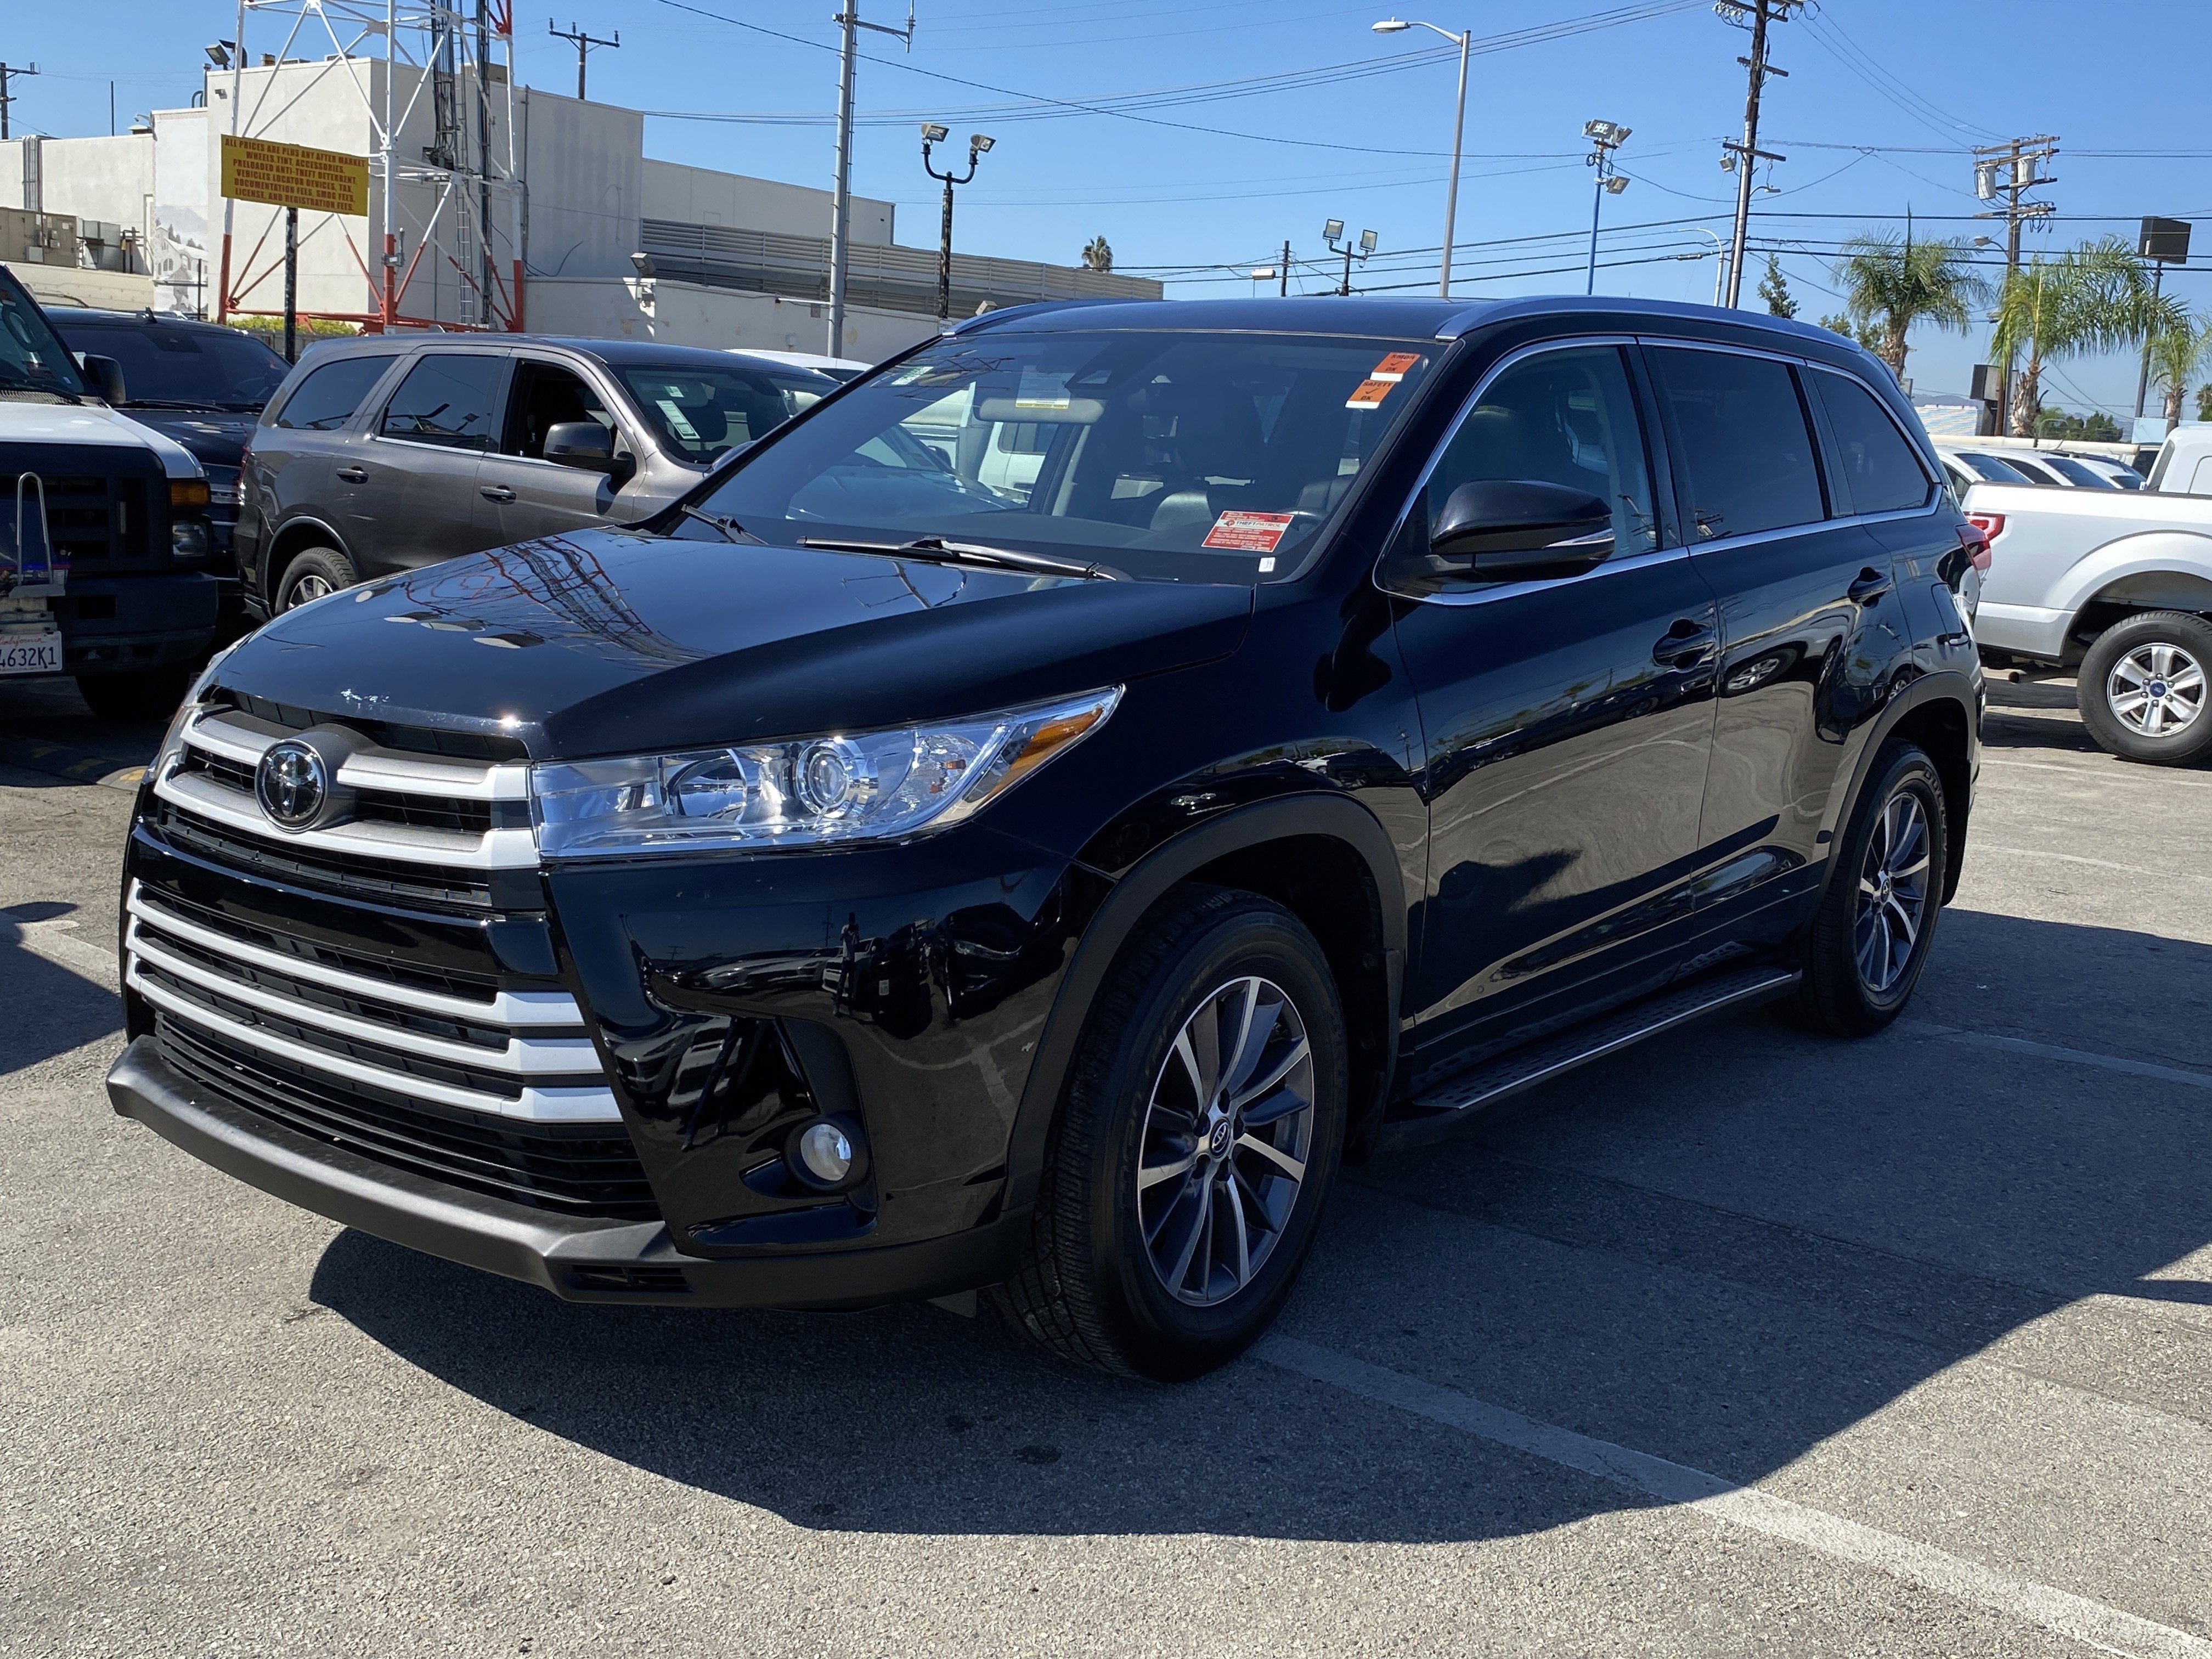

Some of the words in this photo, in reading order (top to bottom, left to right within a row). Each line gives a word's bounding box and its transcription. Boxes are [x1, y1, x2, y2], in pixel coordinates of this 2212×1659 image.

[225, 138, 236, 148] ALL
[239, 140, 264, 151] PRICES
[267, 146, 280, 155] ARE
[282, 147, 299, 157] PLUS
[302, 150, 315, 159] ANY
[316, 153, 336, 163] AFTER
[338, 156, 365, 167] MARKET
[233, 159, 273, 172] PRELOADED
[236, 168, 270, 181] VEHICLES
[273, 174, 304, 185] LOCATOR
[234, 178, 295, 194] DOCUMENTATION
[317, 190, 336, 199] SMOG
[268, 192, 283, 201] AND
[285, 194, 335, 208] REGISTRATION
